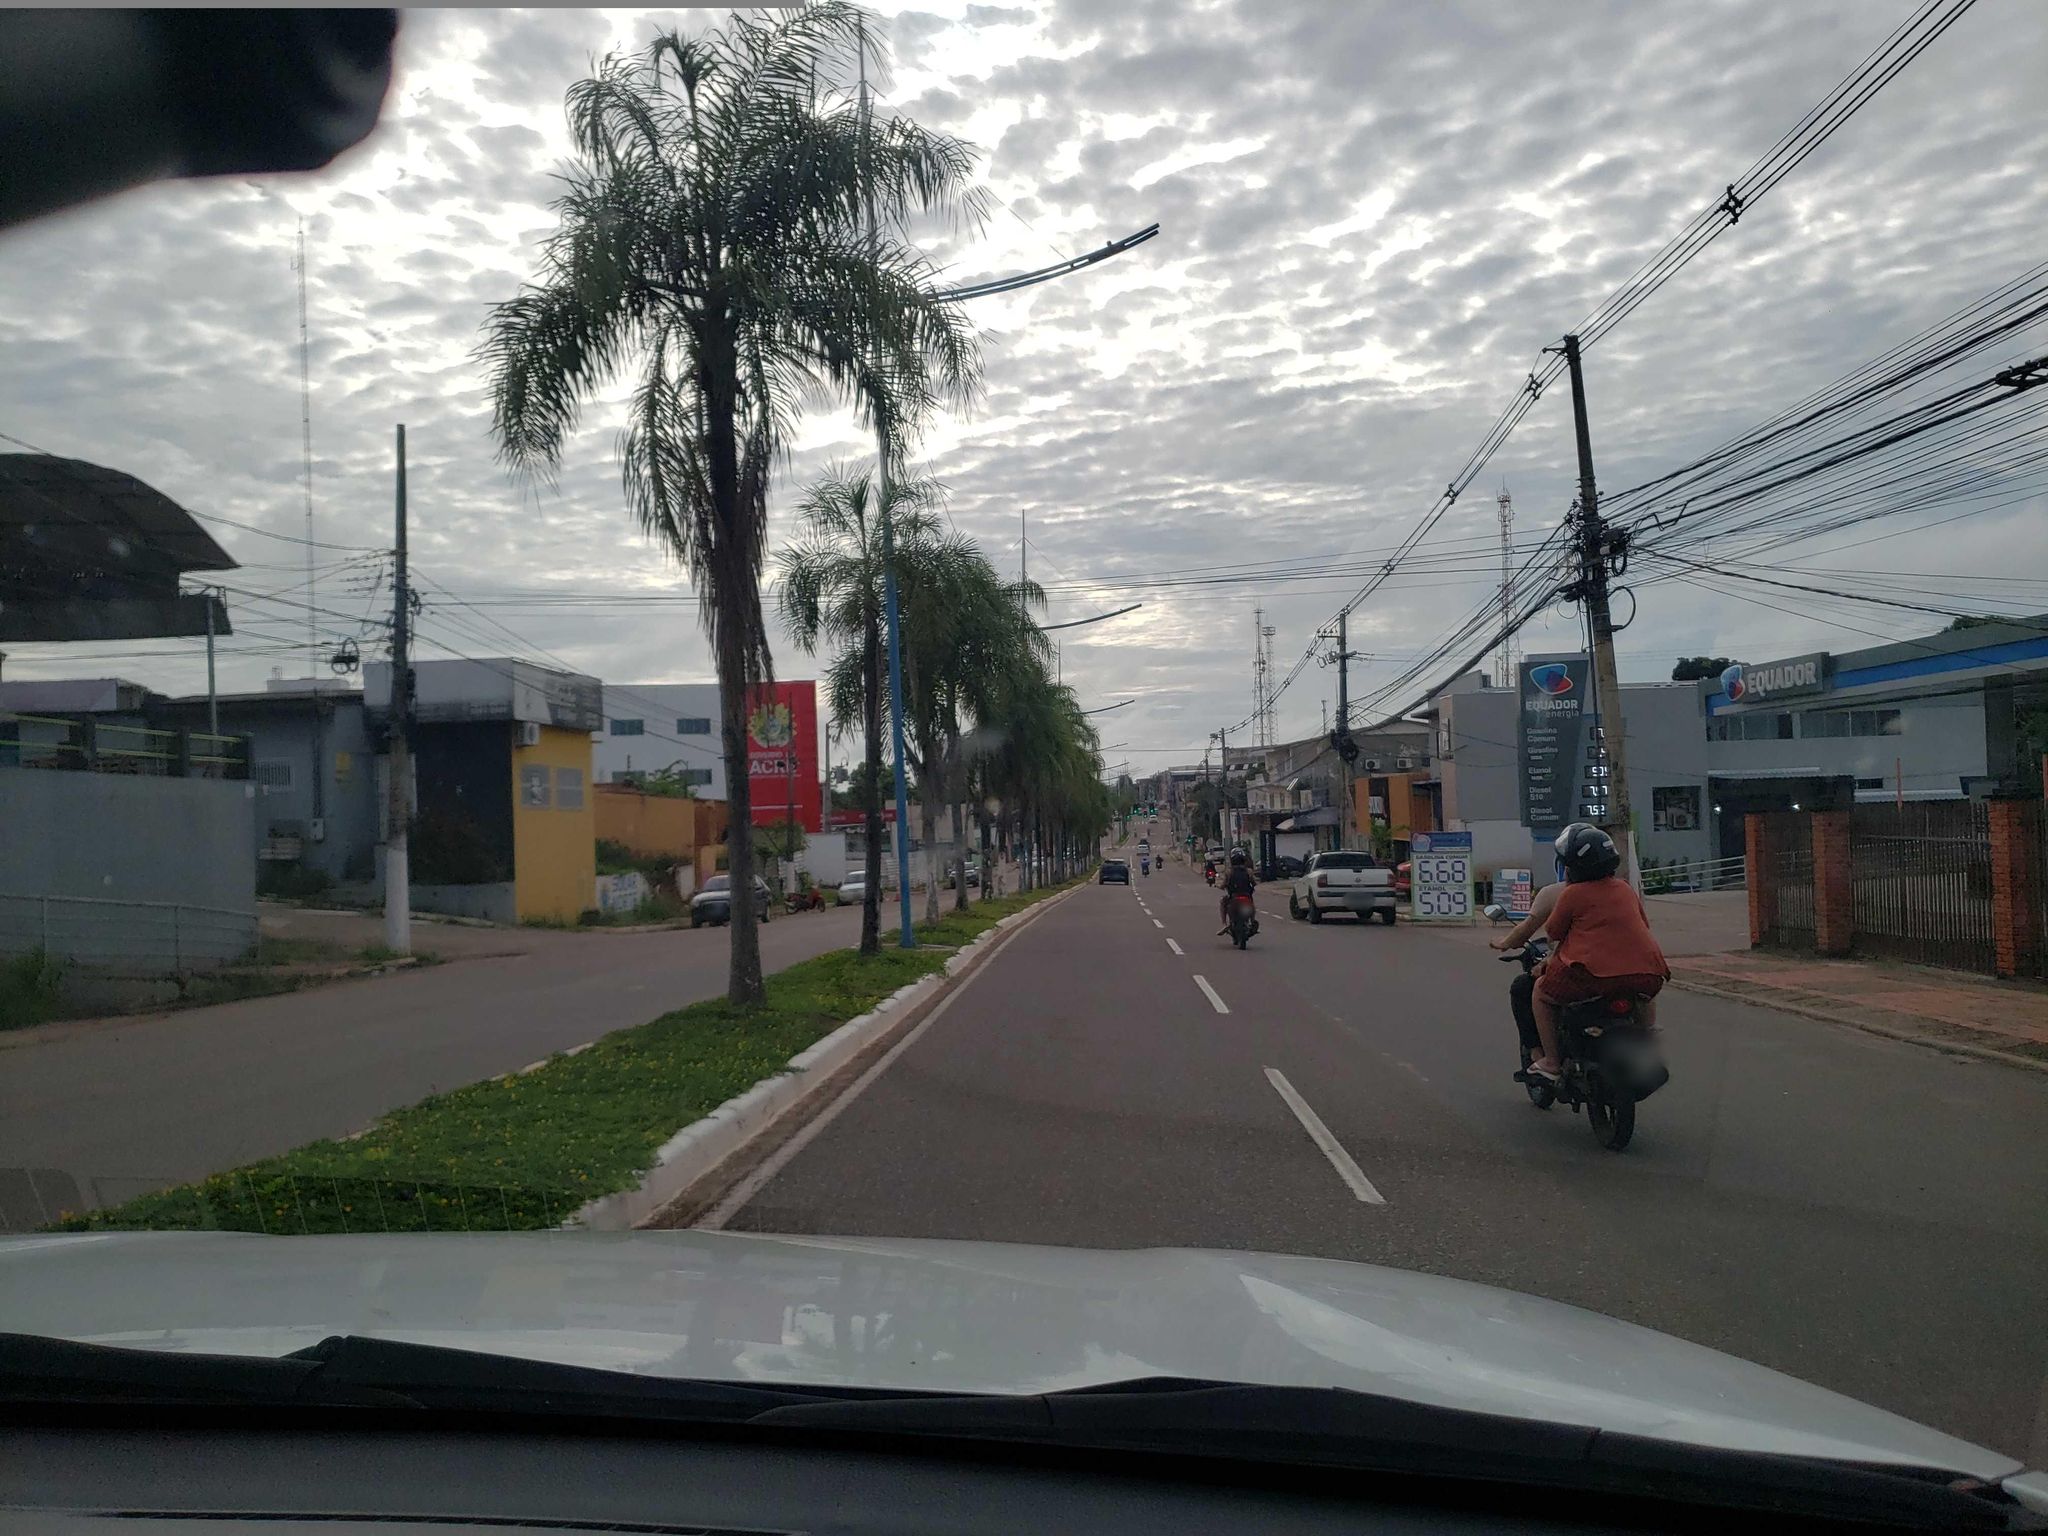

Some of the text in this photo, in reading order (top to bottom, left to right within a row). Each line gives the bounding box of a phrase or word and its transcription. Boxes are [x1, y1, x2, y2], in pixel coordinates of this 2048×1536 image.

[1747, 662, 1816, 696] EQUADOR
[1525, 700, 1578, 711] EQUADOR
[1546, 710, 1579, 718] energia
[1419, 860, 1466, 883] 6.68
[1420, 892, 1467, 915] 5.09
